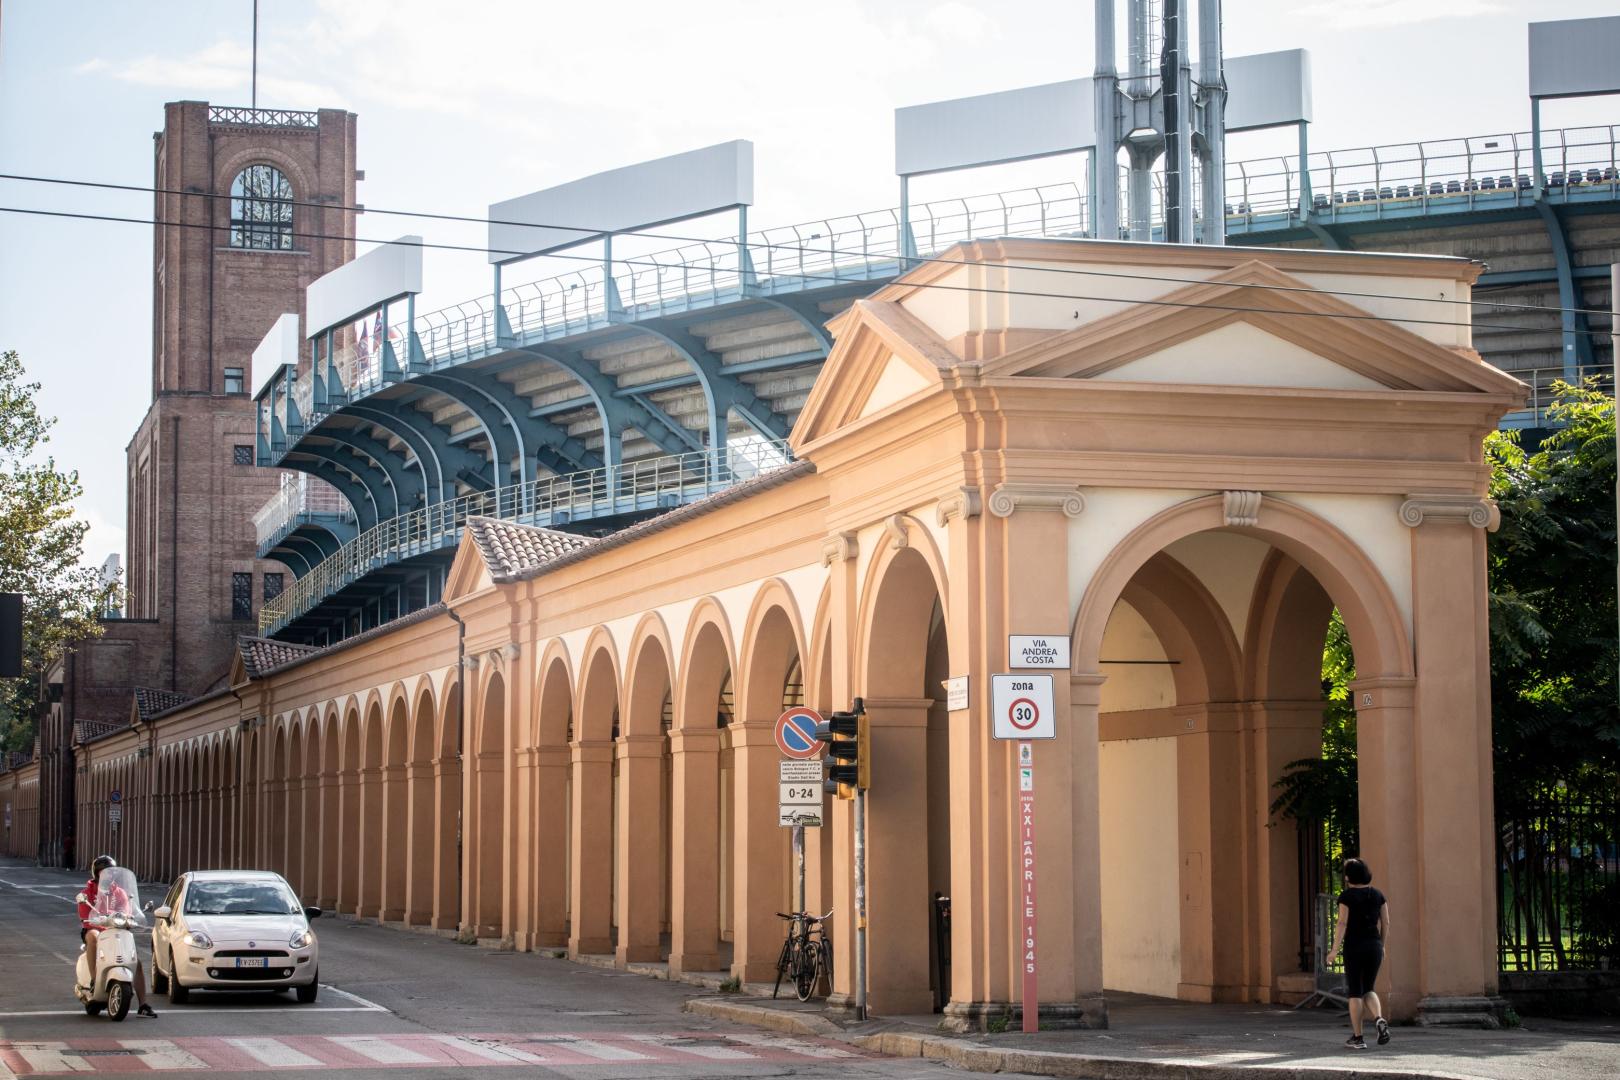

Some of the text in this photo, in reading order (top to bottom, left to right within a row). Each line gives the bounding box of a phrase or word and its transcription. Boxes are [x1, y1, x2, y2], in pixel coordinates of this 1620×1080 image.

[1022, 648, 1058, 656] ANDREA
[1026, 656, 1054, 664] COSTA
[1012, 682, 1034, 690] zona
[1016, 708, 1032, 720] 30
[789, 788, 813, 798] 0-24
[1023, 803, 1032, 838] XXI
[1024, 846, 1034, 918] APRILE
[1026, 926, 1036, 973] 1945
